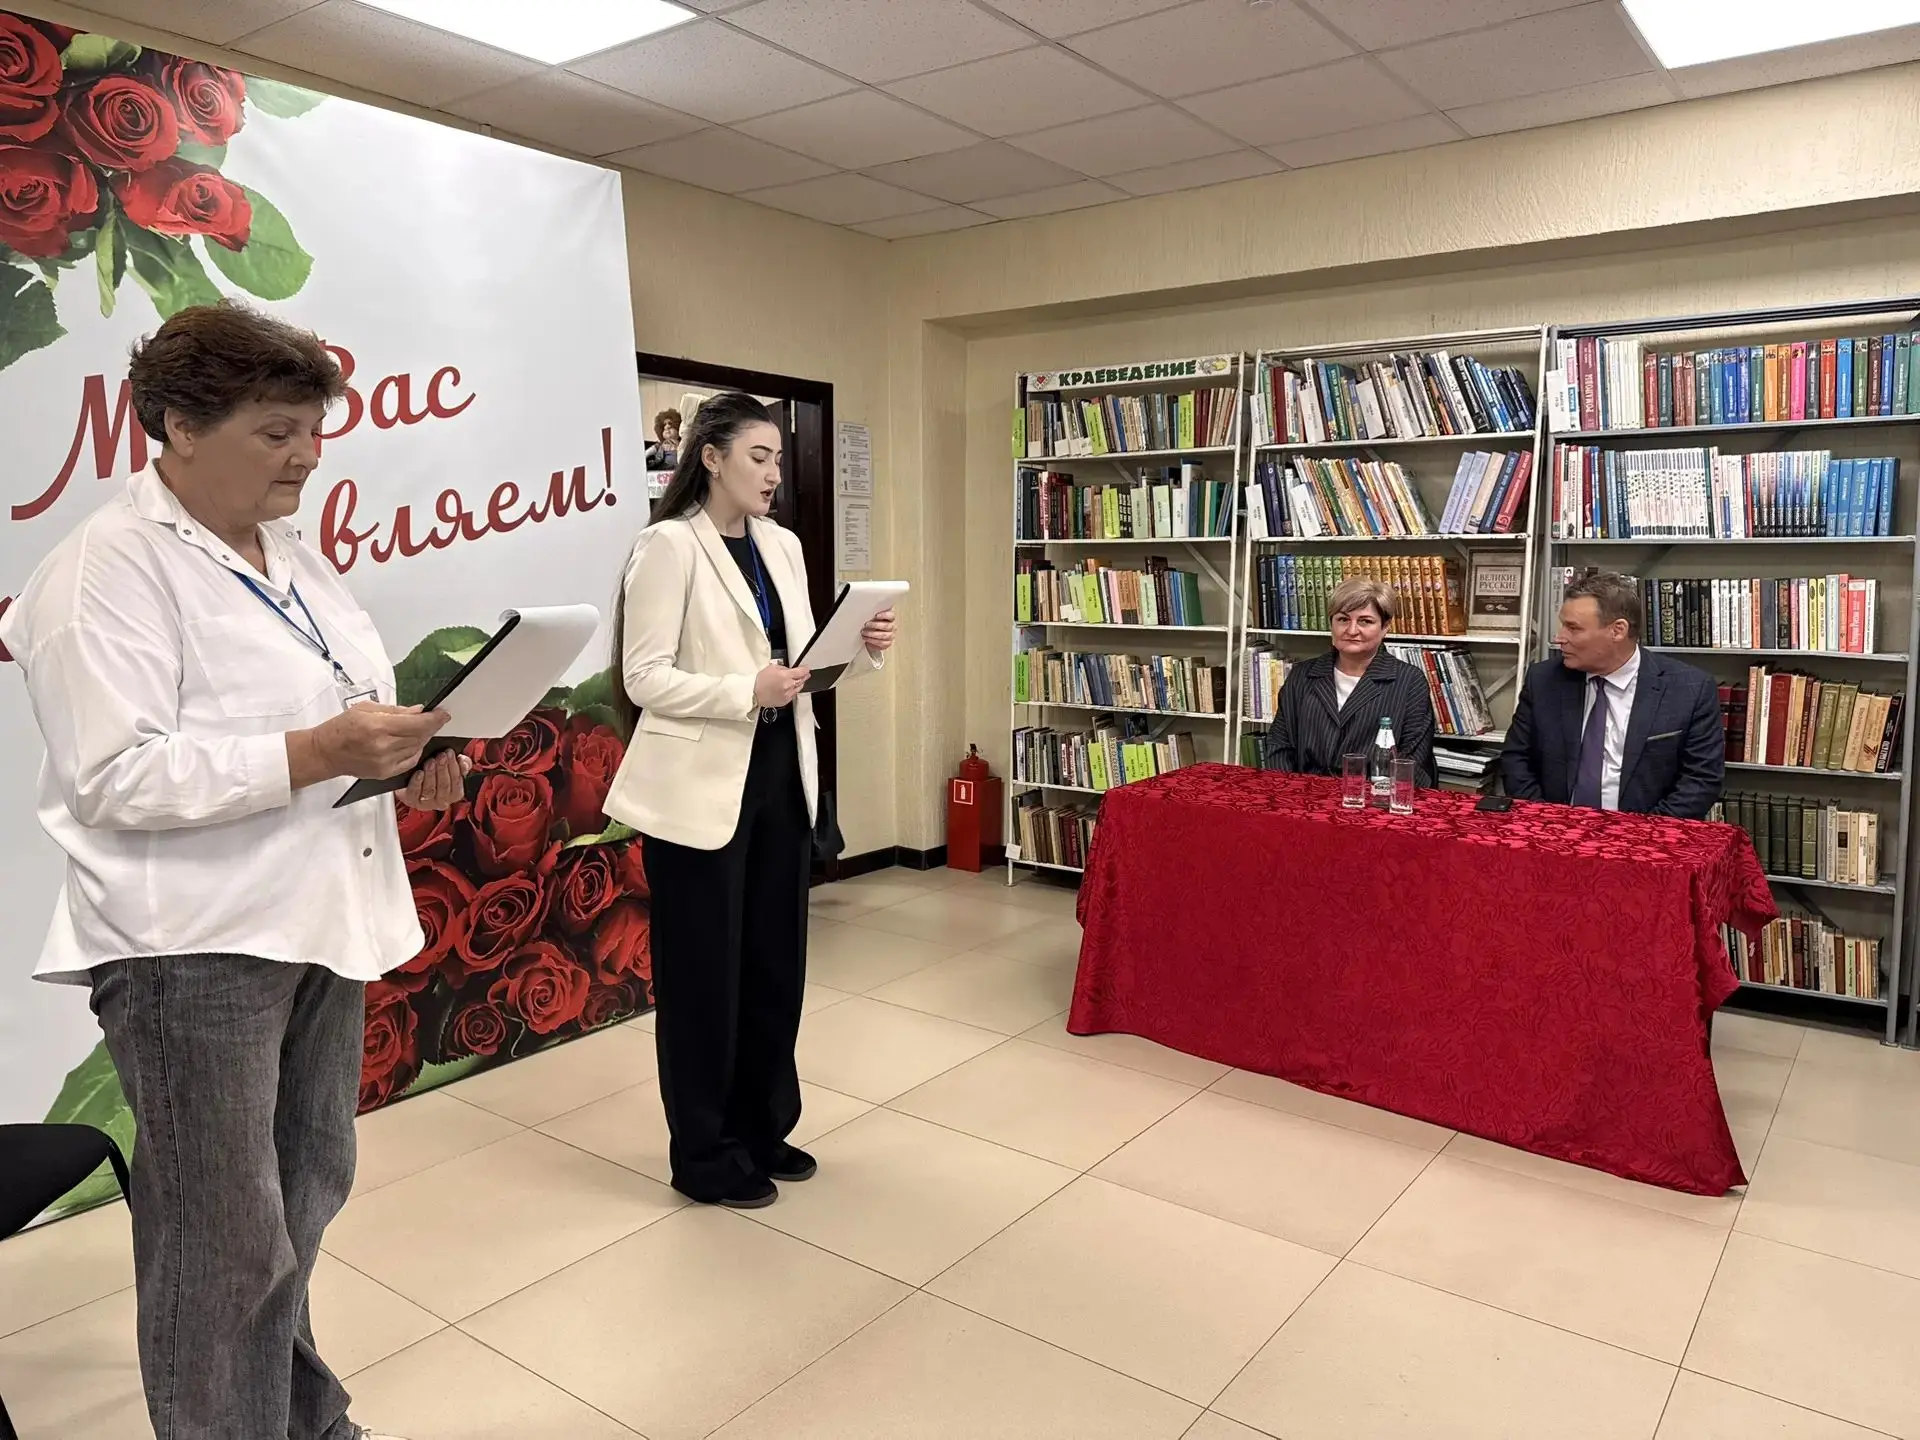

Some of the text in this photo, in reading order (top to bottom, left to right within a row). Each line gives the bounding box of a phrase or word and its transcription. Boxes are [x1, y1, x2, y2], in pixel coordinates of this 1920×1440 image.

[1058, 360, 1197, 386] КРАЕВЕДЕНИЕ
[11, 339, 476, 520] М Вас
[320, 426, 617, 575] вляем!
[1479, 573, 1517, 581] ВЕЛИКИЕ
[1479, 581, 1517, 590] РУССКИЕ
